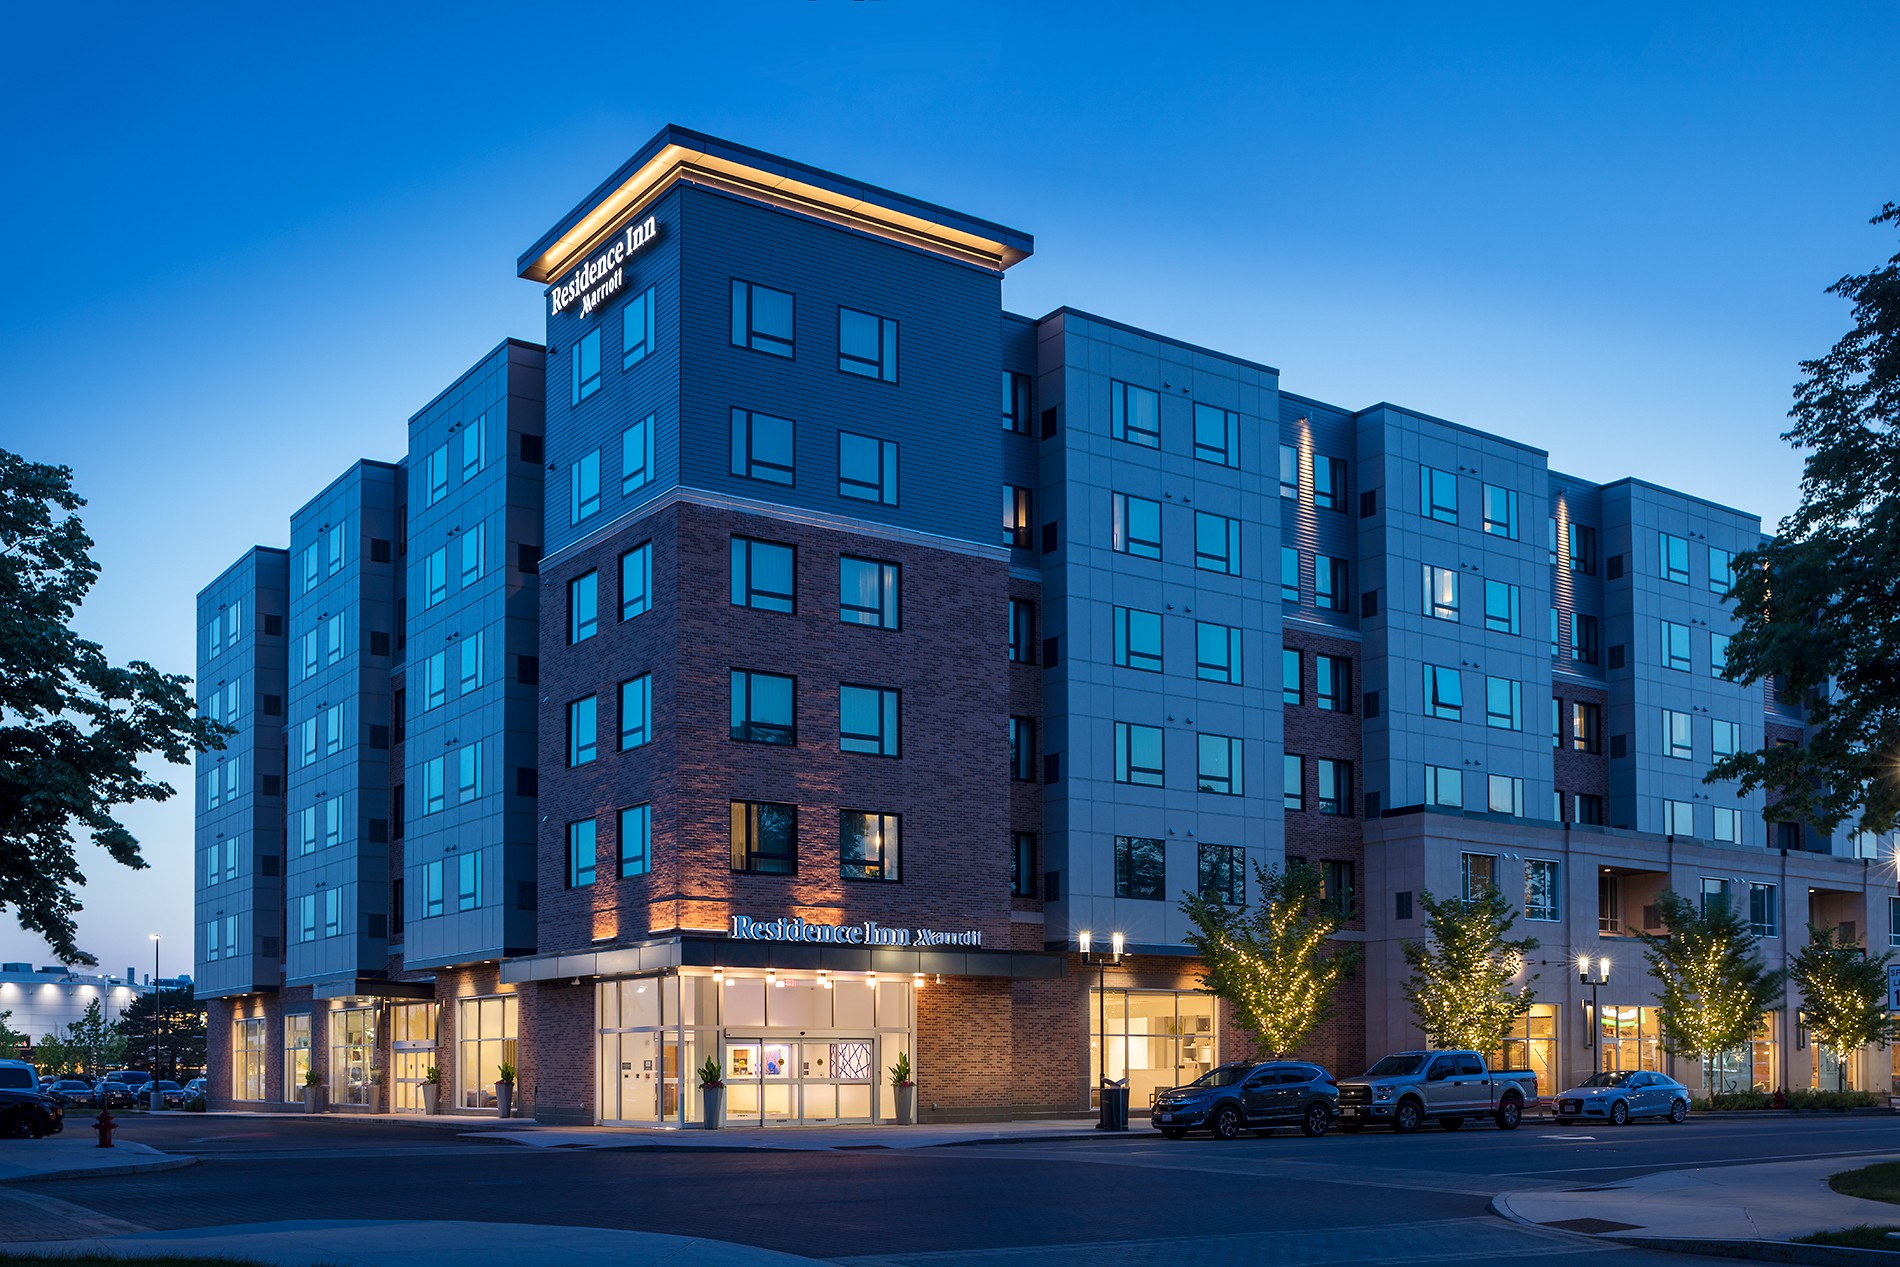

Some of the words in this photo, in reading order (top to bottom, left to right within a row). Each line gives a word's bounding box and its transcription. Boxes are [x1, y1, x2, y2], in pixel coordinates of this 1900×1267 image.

[551, 240, 624, 316] Residence
[626, 216, 657, 256] Inn
[579, 267, 623, 319] Marriott
[731, 914, 863, 944] Residence
[864, 921, 910, 946] Inn
[913, 928, 981, 946] Marriott
